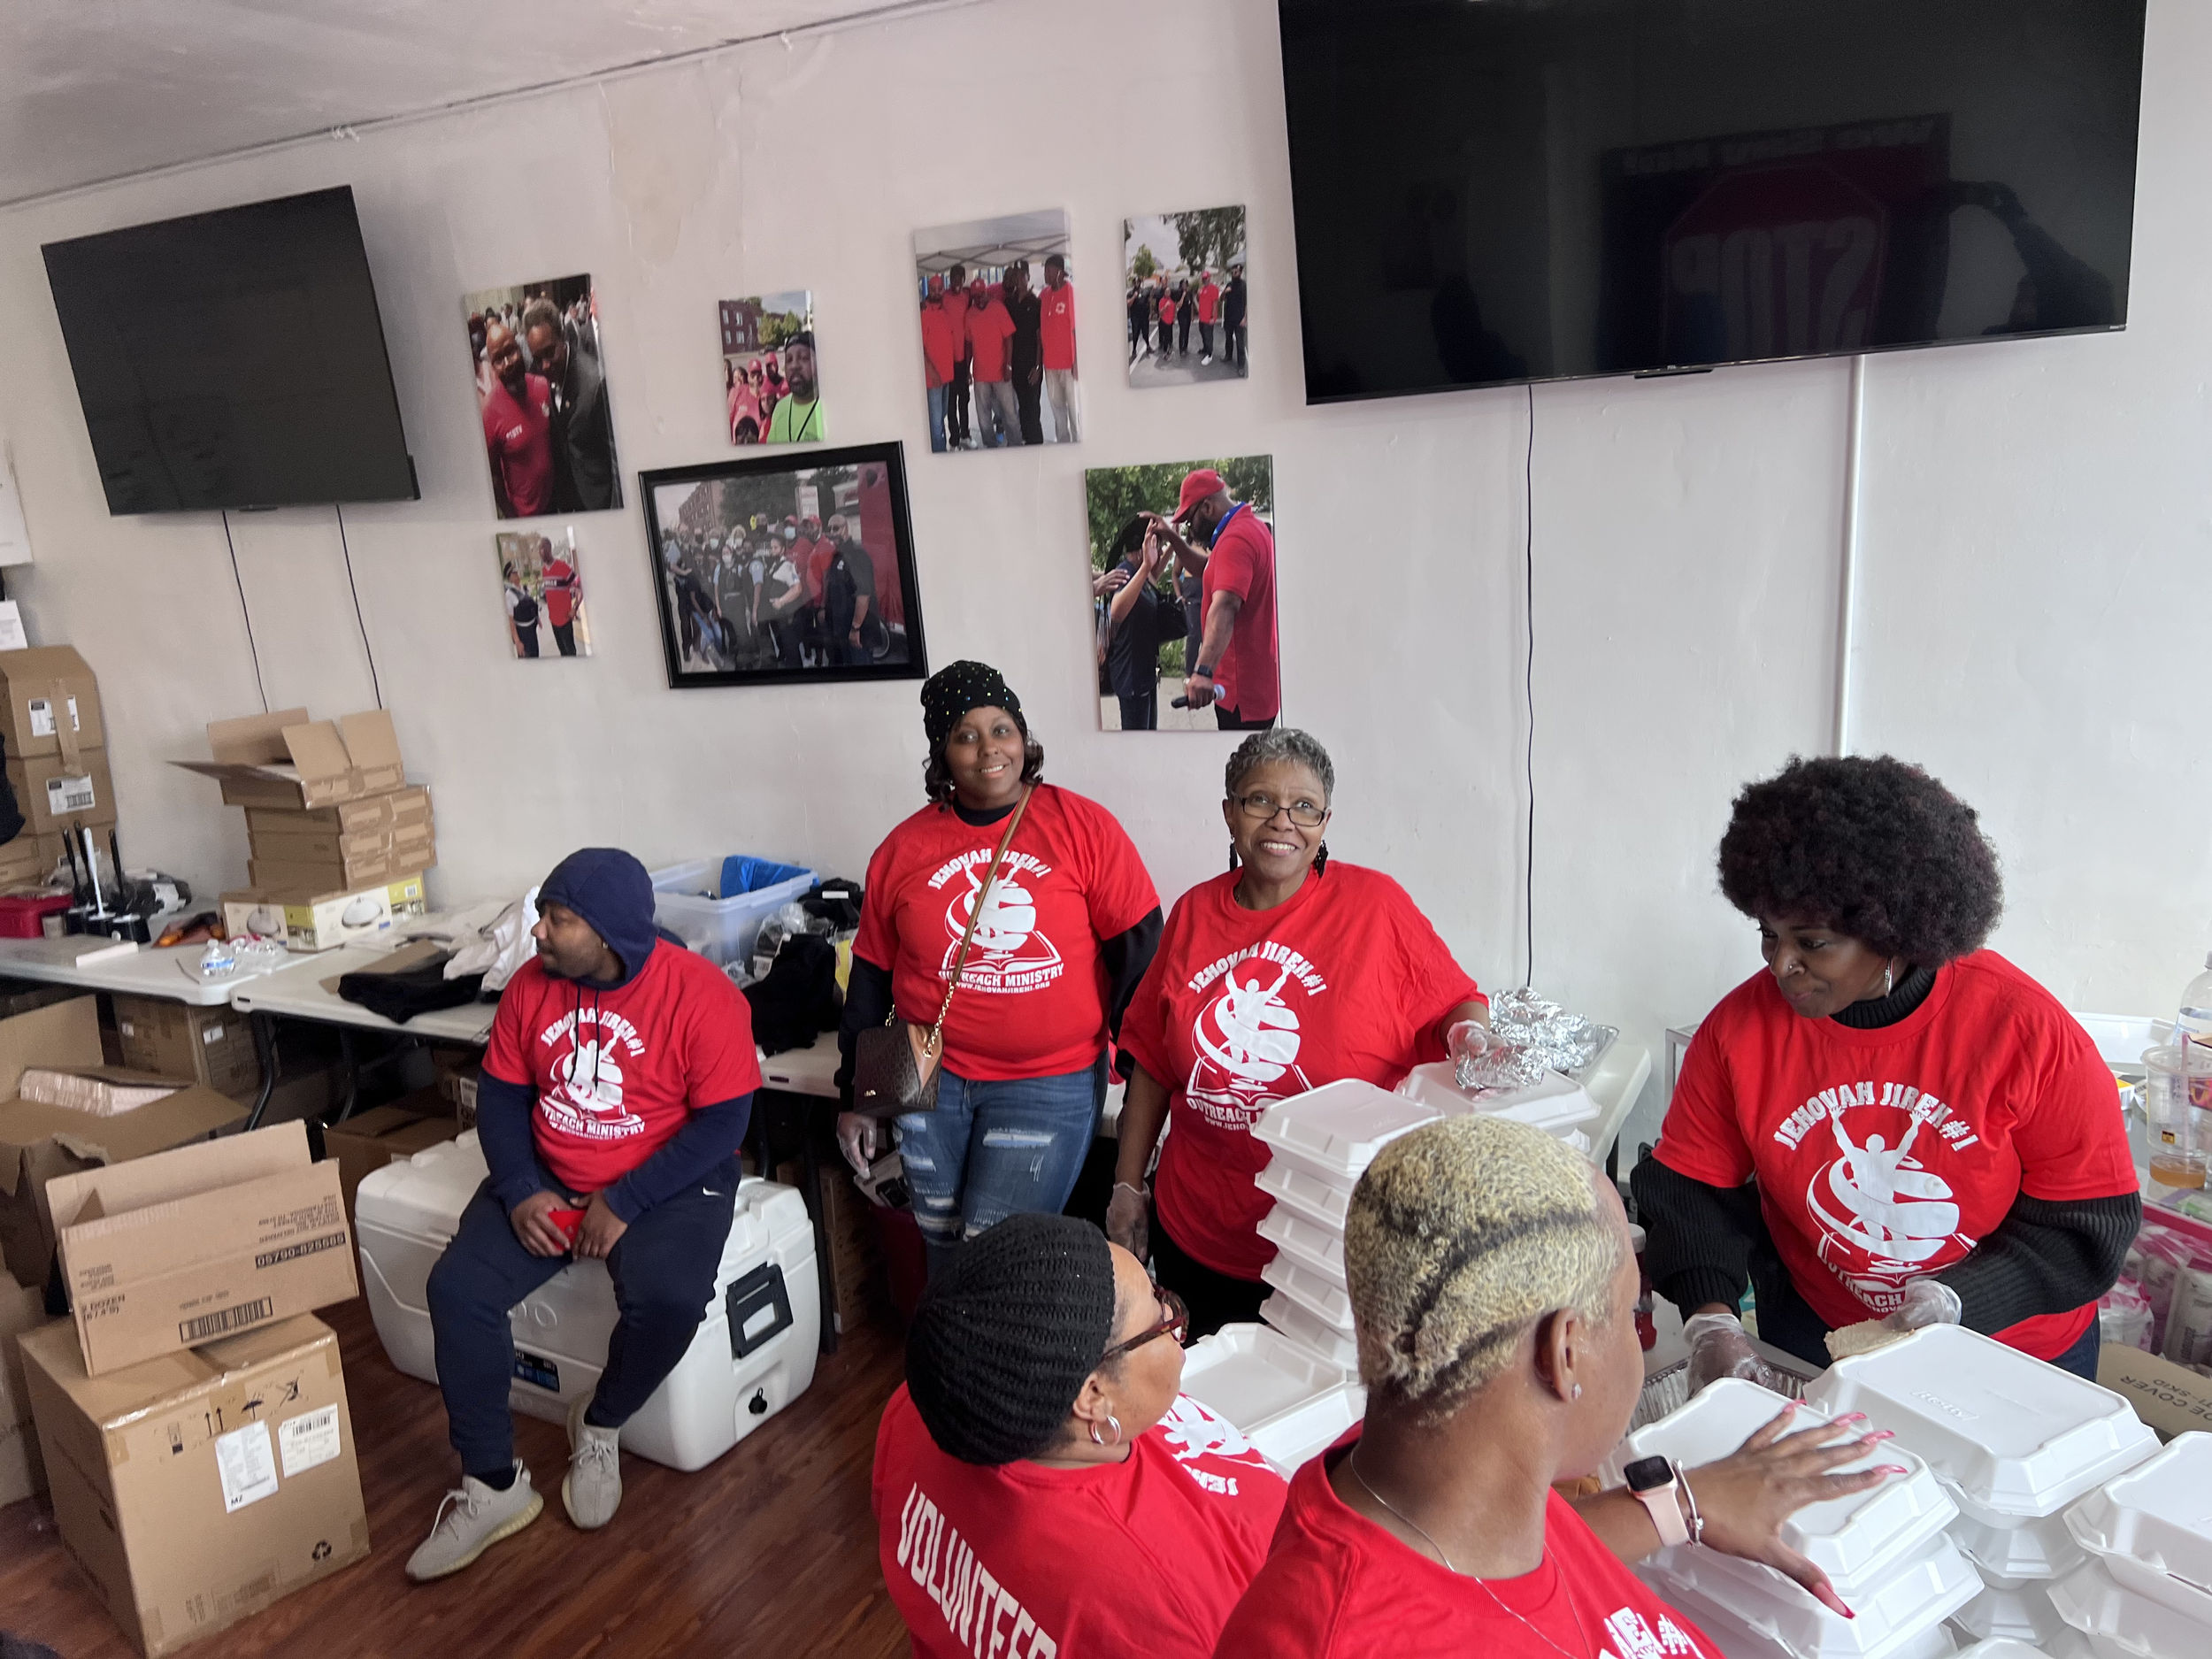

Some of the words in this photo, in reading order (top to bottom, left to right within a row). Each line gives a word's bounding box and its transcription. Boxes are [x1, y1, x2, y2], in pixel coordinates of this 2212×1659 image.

[928, 849, 992, 889] JEHOVAH
[1005, 963, 1064, 987] MINISTRY
[1188, 941, 1260, 994] JEHOVAH
[1261, 941, 1314, 979] JIREH
[600, 1010, 636, 1041] JIREH
[1187, 1097, 1251, 1125] OUTREACH
[1773, 1081, 1875, 1150] JEHOVAH
[1879, 1082, 1954, 1129] JIREH
[586, 1119, 645, 1136] MINISTRY
[2120, 1376, 2187, 1408] COVER
